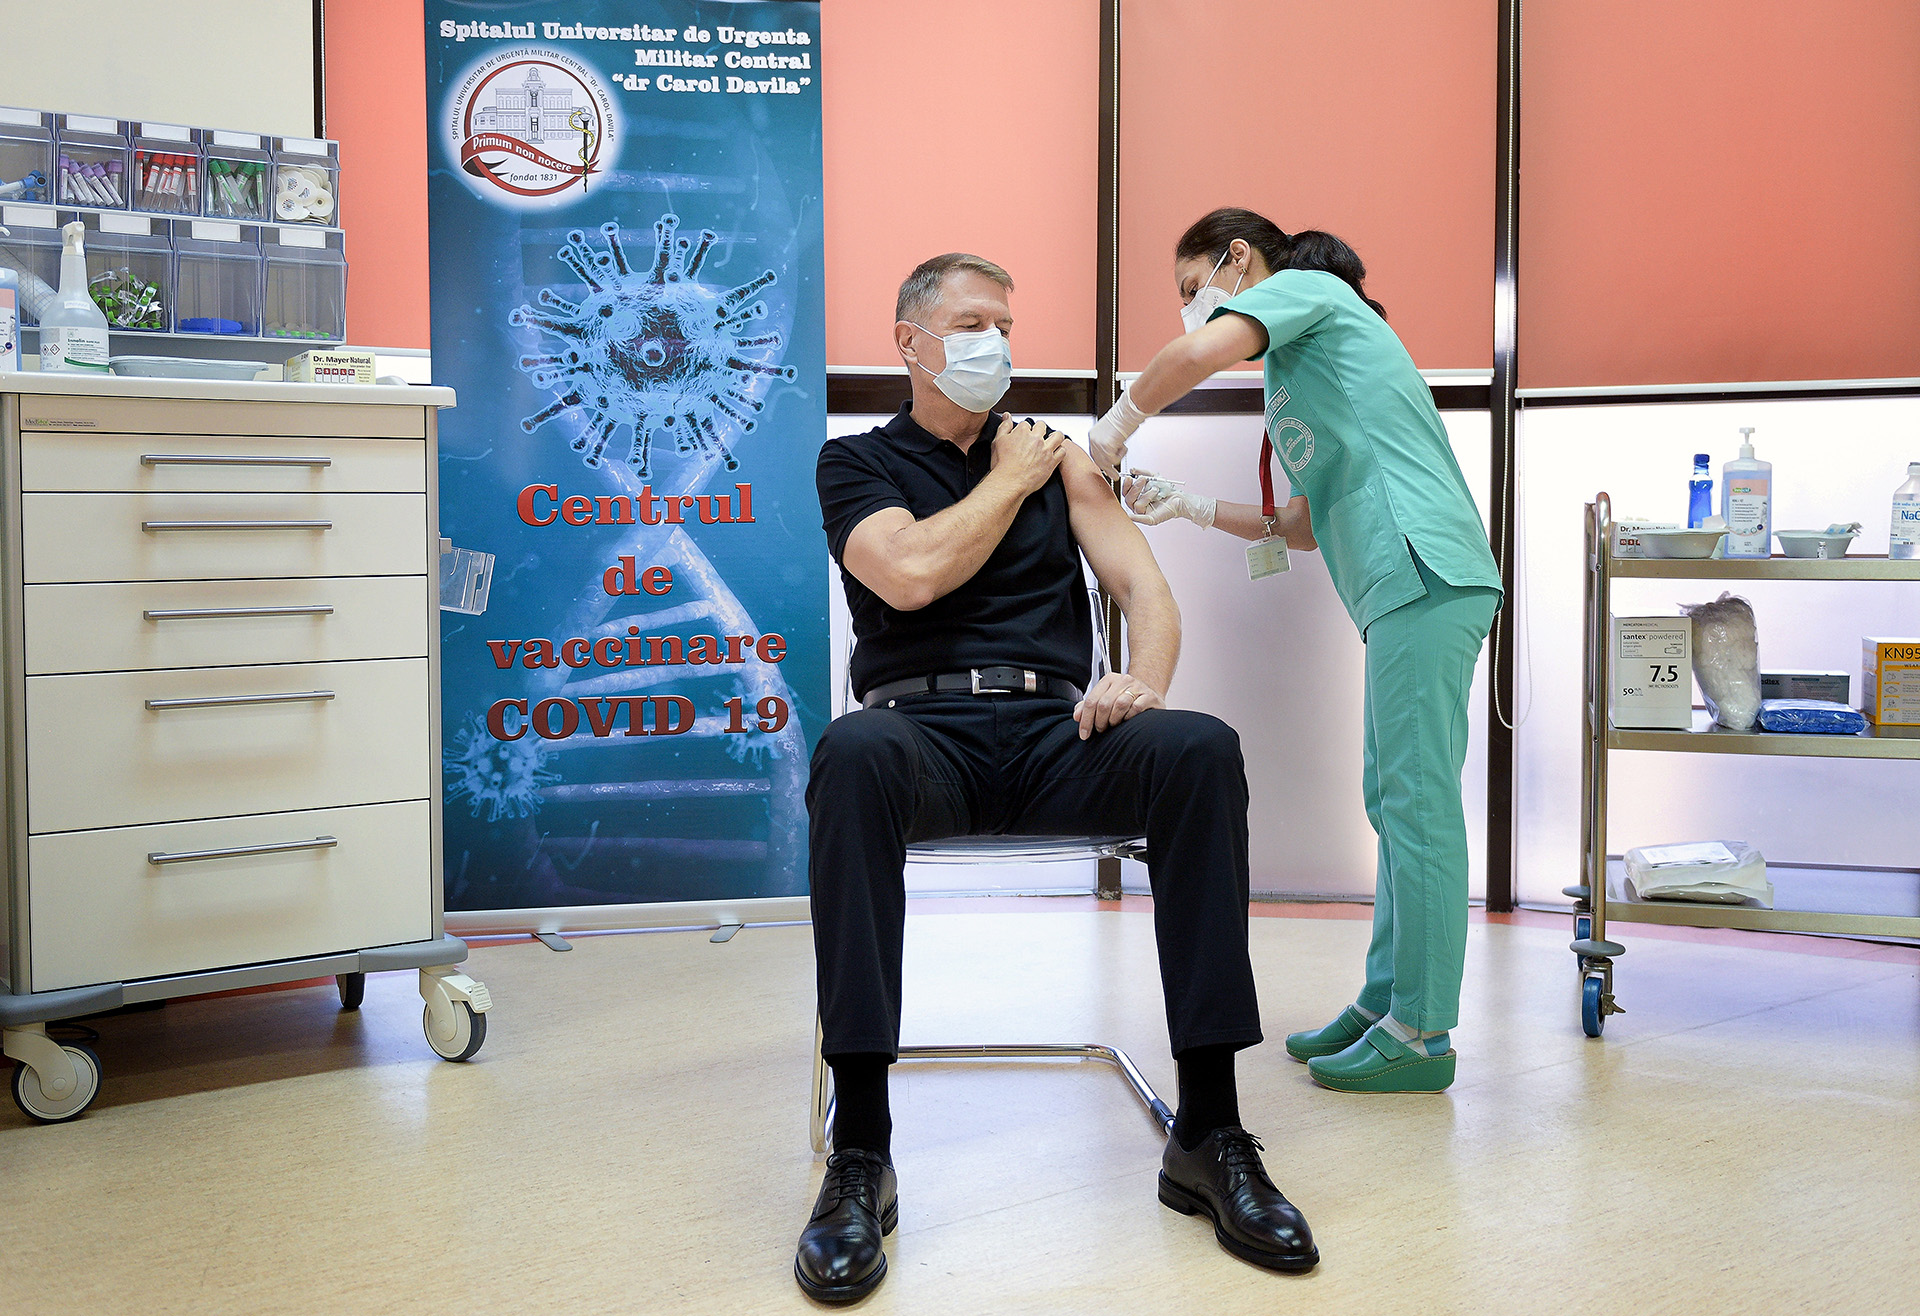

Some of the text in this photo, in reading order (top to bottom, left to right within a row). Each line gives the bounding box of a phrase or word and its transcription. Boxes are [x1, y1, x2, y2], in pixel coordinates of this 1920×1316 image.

[439, 20, 811, 48] Spitalul Universitar de Urgenta
[485, 58, 497, 68] DE
[530, 49, 560, 60] MILITAR
[634, 49, 811, 70] Militar Central
[560, 55, 589, 78] CENTRAL
[456, 65, 486, 105] UNIVERSITAR
[656, 74, 721, 93] Carol
[597, 89, 611, 113] CAROL
[452, 107, 461, 140] SPITALUL
[472, 135, 572, 172] Primum non nocere
[509, 172, 558, 183] fondat 1831
[313, 355, 325, 363] Dr.
[325, 356, 350, 365] Mayer
[349, 356, 371, 364] Natural
[517, 483, 756, 527] Centrul
[602, 555, 674, 598] de
[486, 625, 788, 670] vaccinare
[1649, 633, 1683, 641] powdered
[1884, 647, 1920, 660] KN95
[1649, 665, 1678, 683] 7.5
[486, 694, 790, 742] COVID 19
